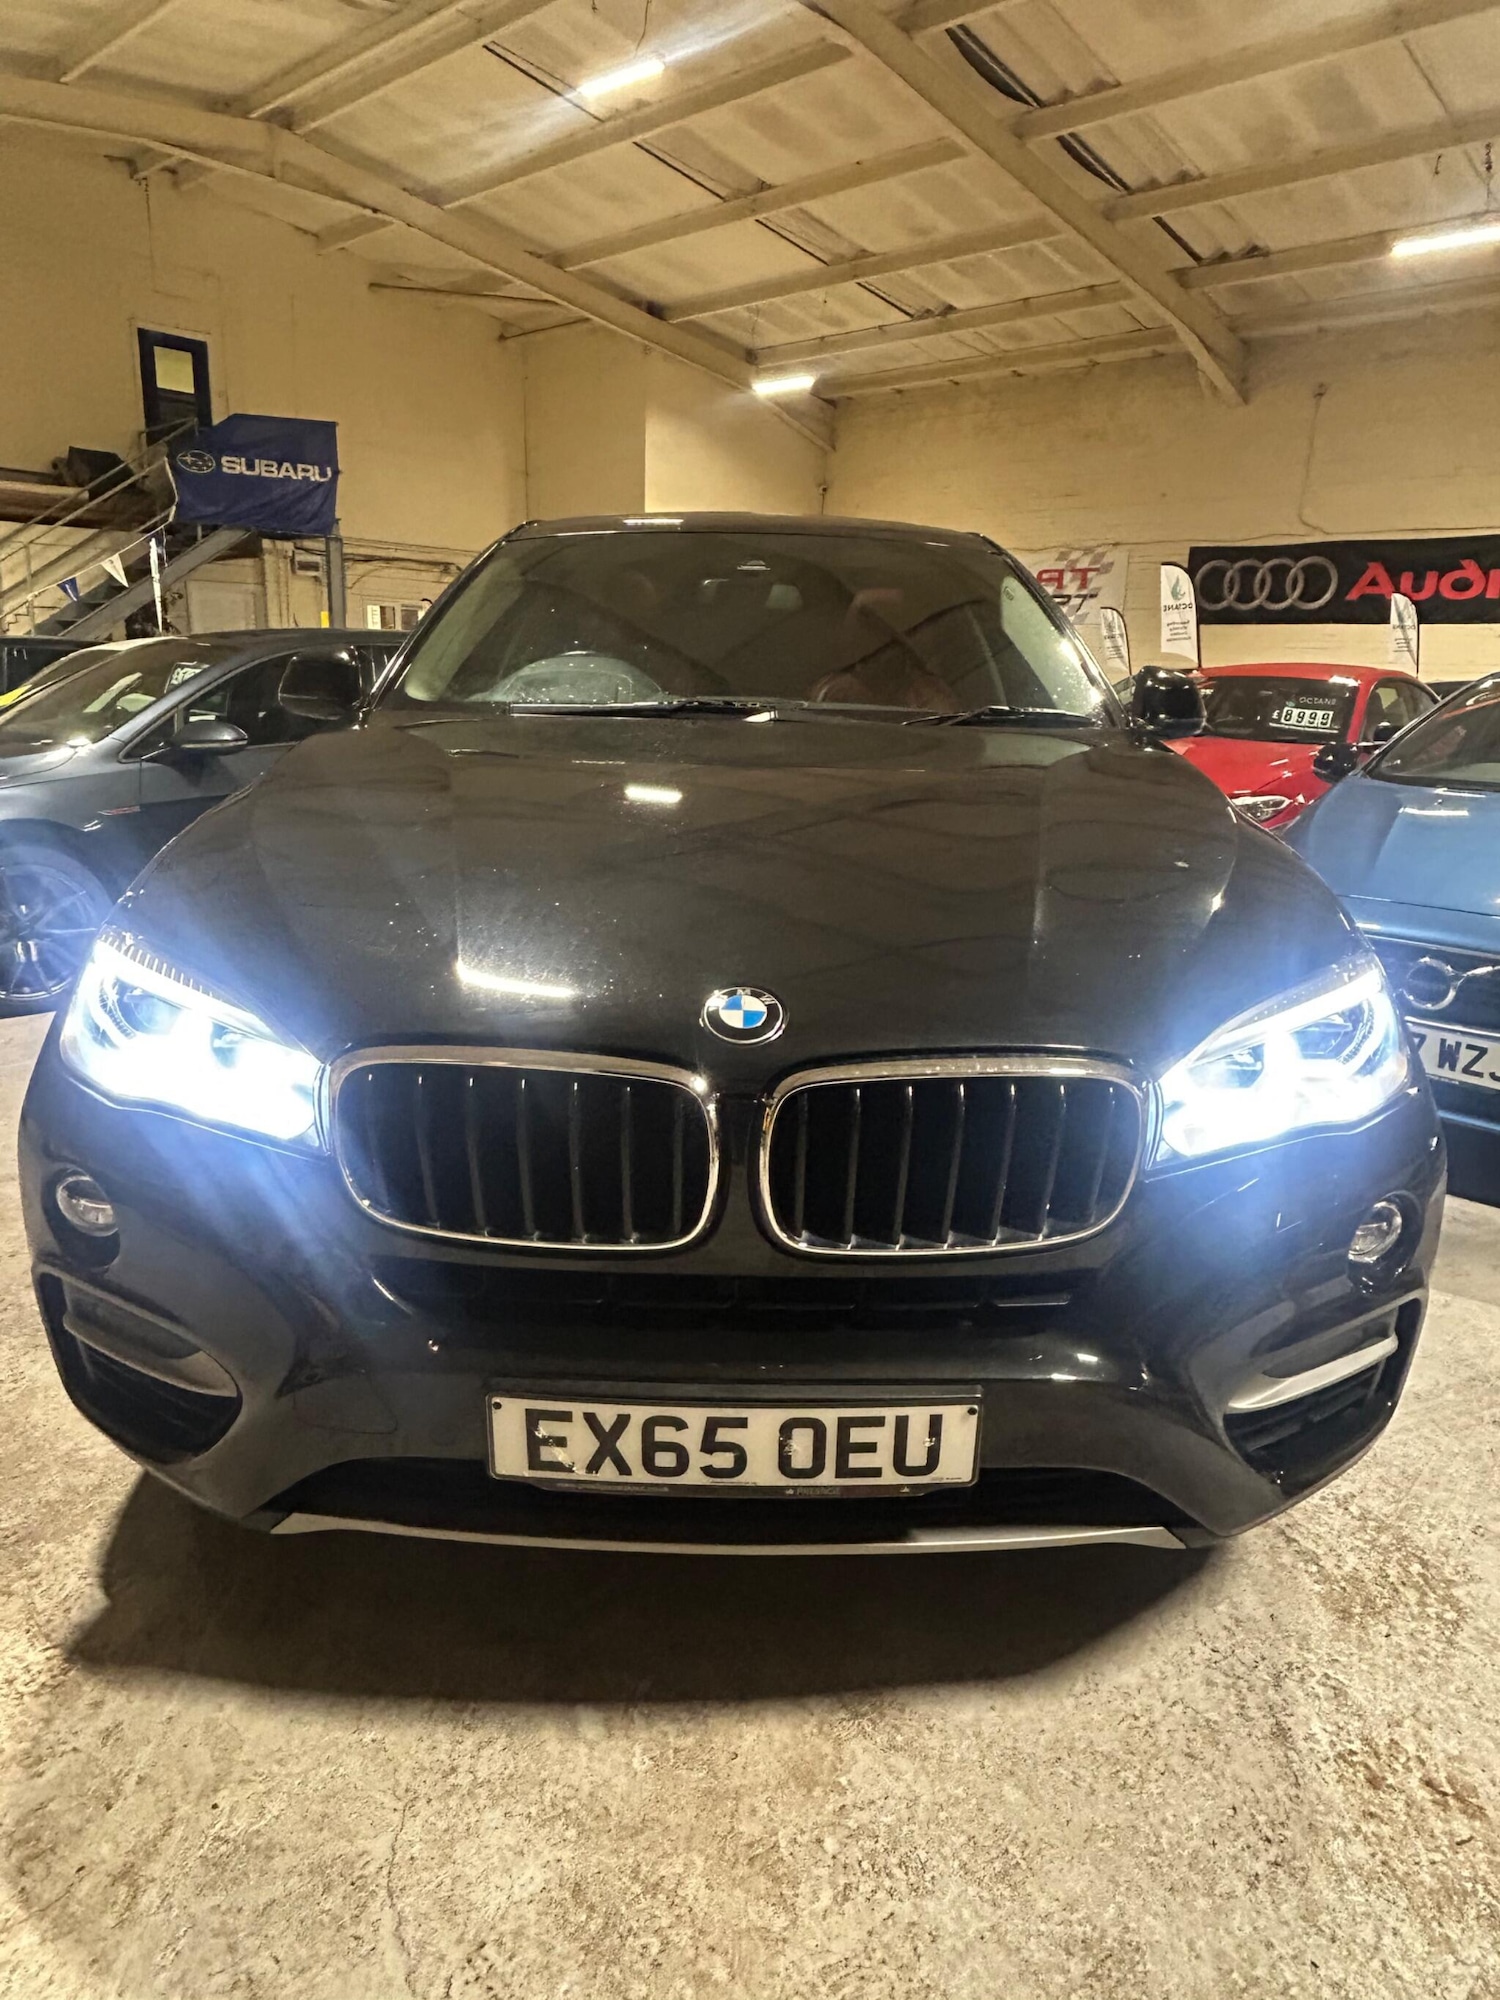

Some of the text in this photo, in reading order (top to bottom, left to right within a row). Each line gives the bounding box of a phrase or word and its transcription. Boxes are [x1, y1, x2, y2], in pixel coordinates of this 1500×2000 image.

[221, 456, 332, 482] SUBARU
[524, 1408, 943, 1479] EX65 OEU
